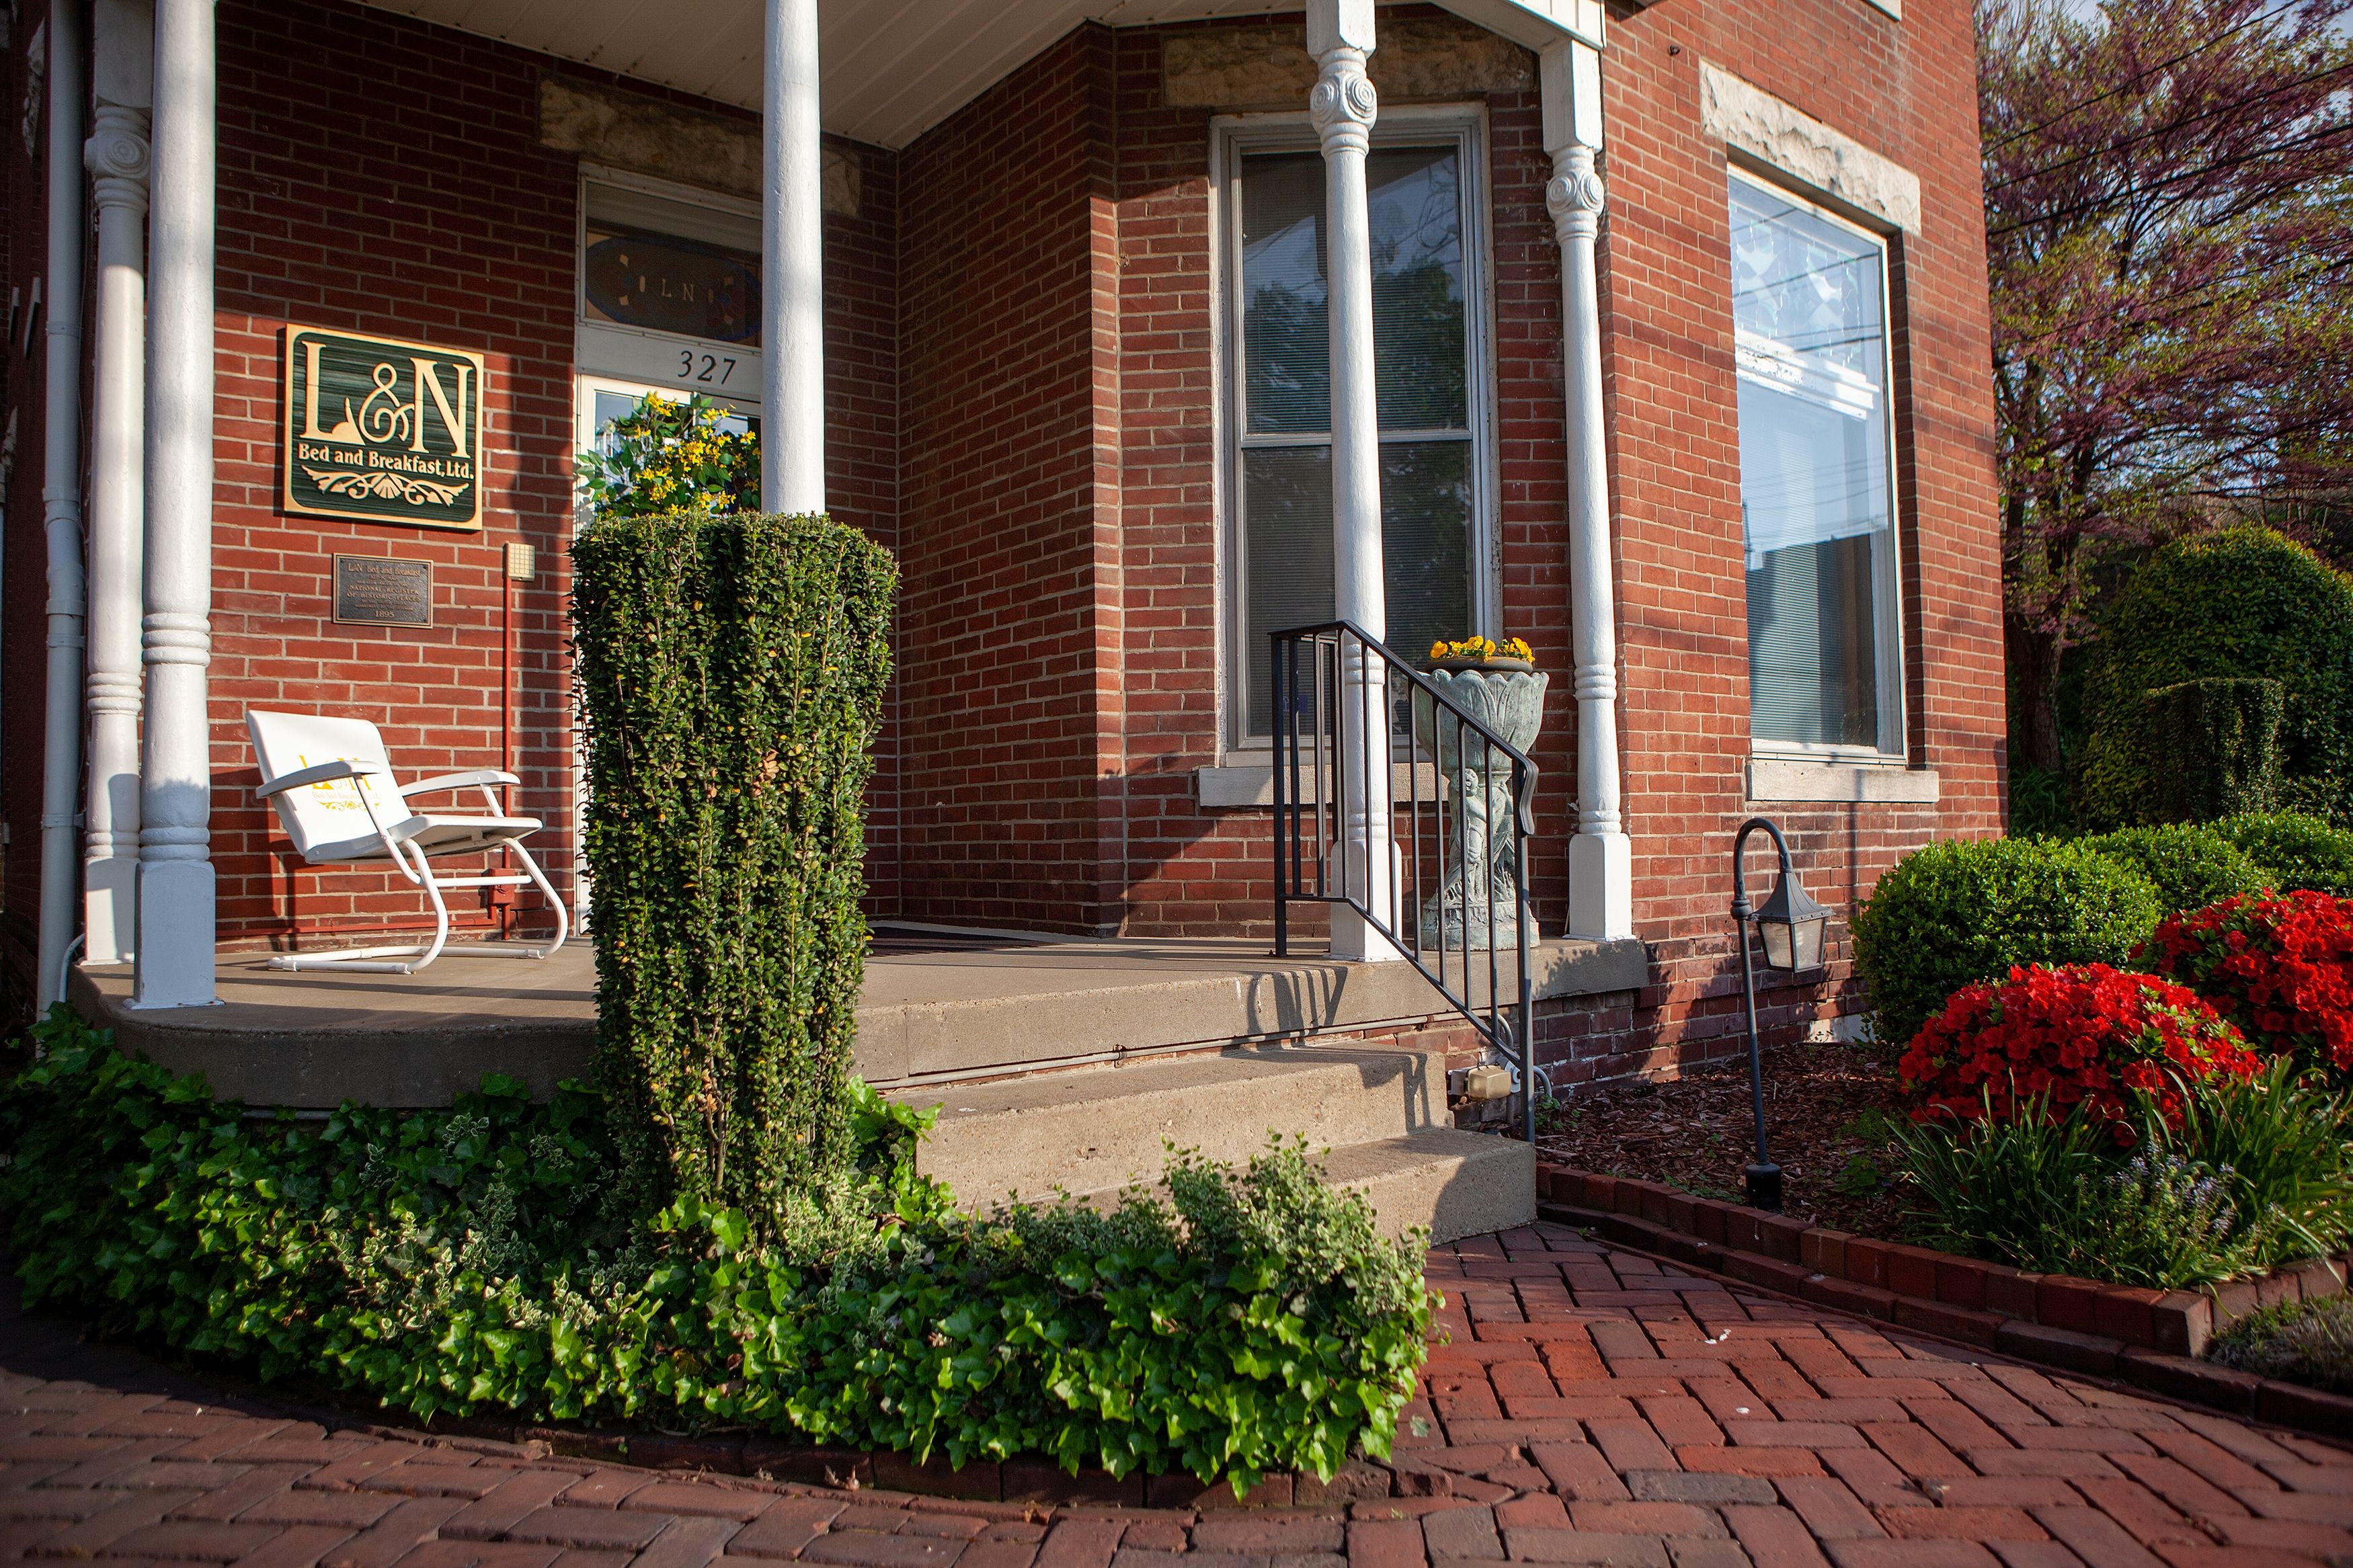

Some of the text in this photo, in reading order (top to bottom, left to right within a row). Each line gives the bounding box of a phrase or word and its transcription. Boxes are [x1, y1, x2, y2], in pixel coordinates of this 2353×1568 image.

[677, 350, 737, 385] 327
[299, 341, 474, 458] L&N
[298, 442, 475, 480] Bed and Breakfast, Ltd.
